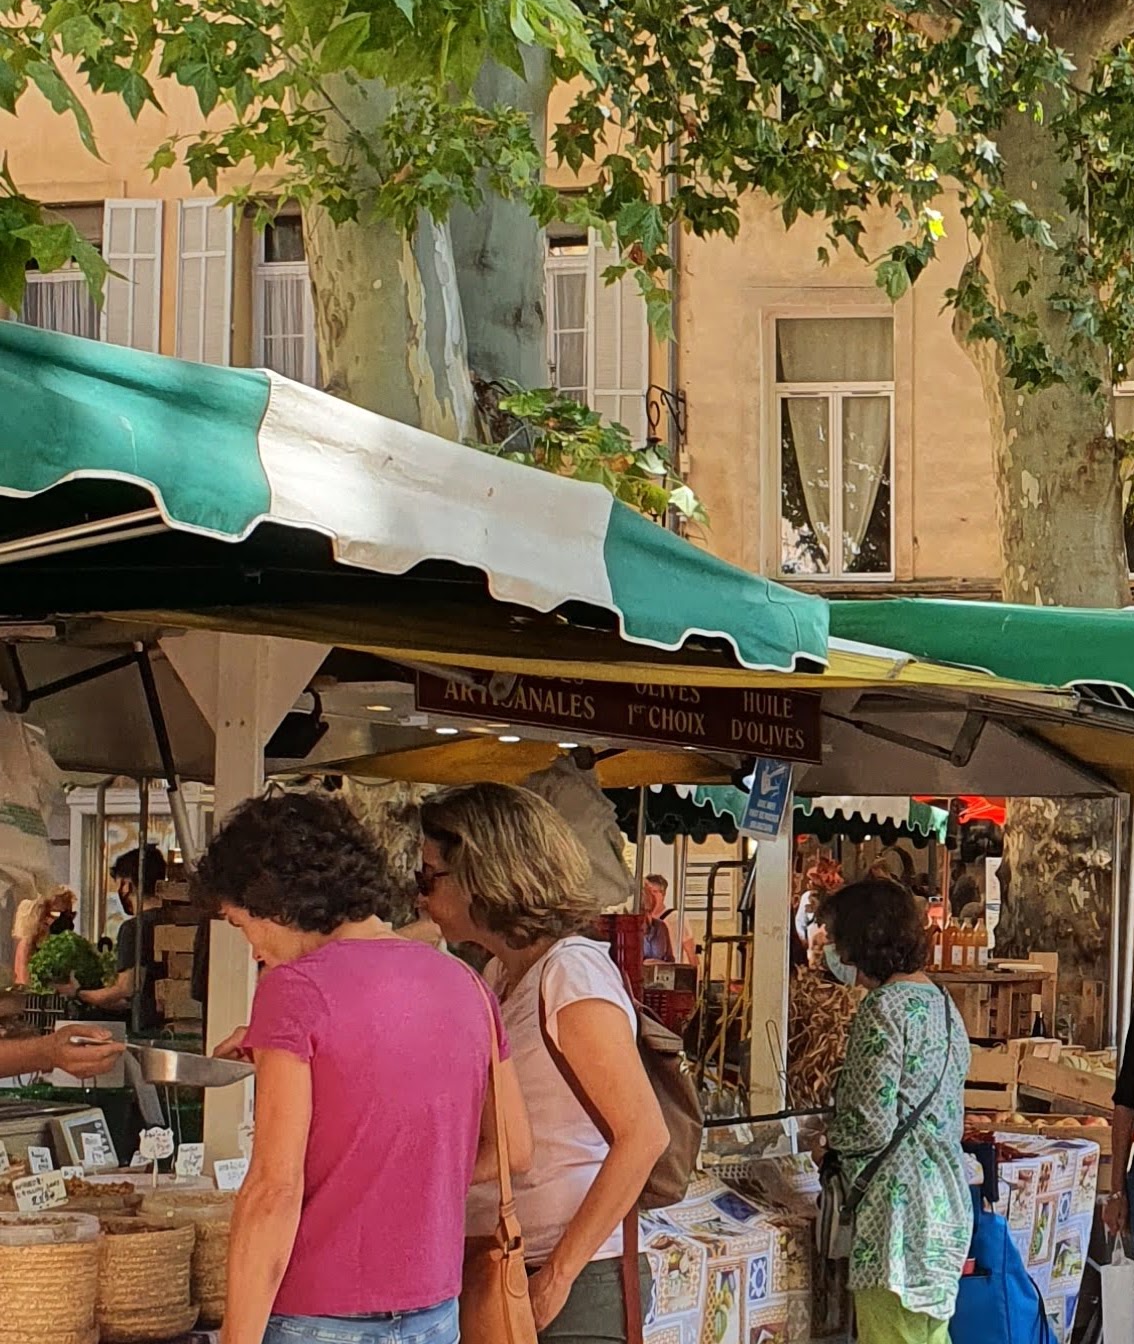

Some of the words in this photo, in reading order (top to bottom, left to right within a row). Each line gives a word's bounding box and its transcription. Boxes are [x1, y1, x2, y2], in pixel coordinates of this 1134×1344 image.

[743, 691, 794, 719] HUILE
[648, 706, 706, 736] CHOIX
[731, 719, 805, 750] D'OLIVES
